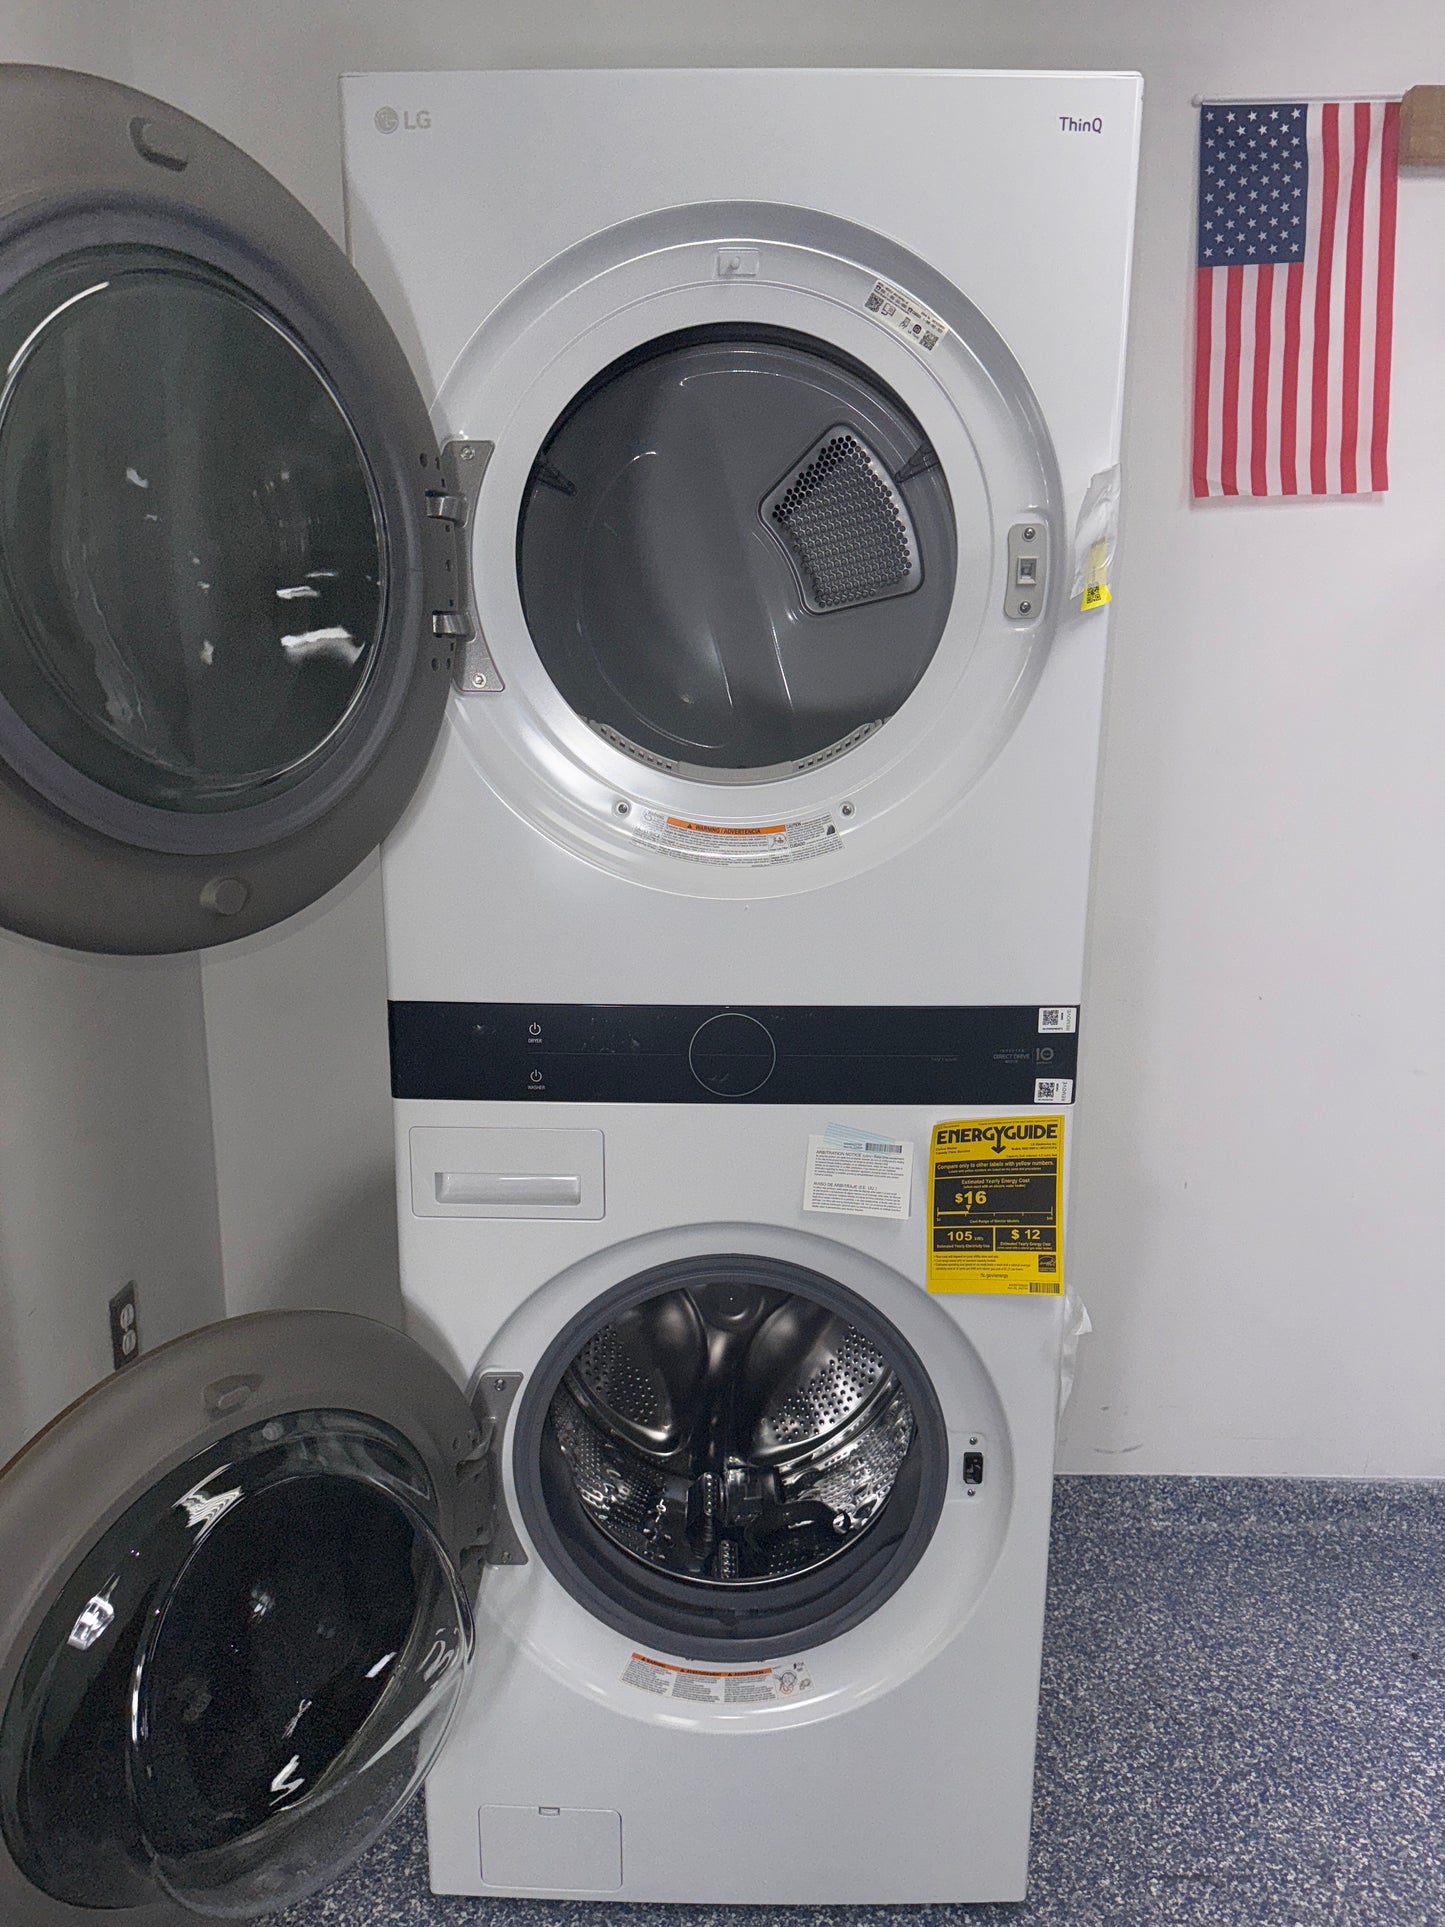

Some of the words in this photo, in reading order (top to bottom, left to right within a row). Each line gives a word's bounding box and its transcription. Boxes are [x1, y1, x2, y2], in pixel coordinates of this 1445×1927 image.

[404, 110, 431, 129] LG
[1059, 116, 1102, 134] ThinQ
[695, 824, 720, 834] WARNING
[724, 827, 760, 835] ADVERTENCIA
[937, 1124, 1058, 1145] ENERGYGUIDE
[954, 1190, 987, 1204] $16
[947, 1231, 972, 1241] 105
[1011, 1228, 1020, 1240] $
[1024, 1229, 1040, 1240] 12
